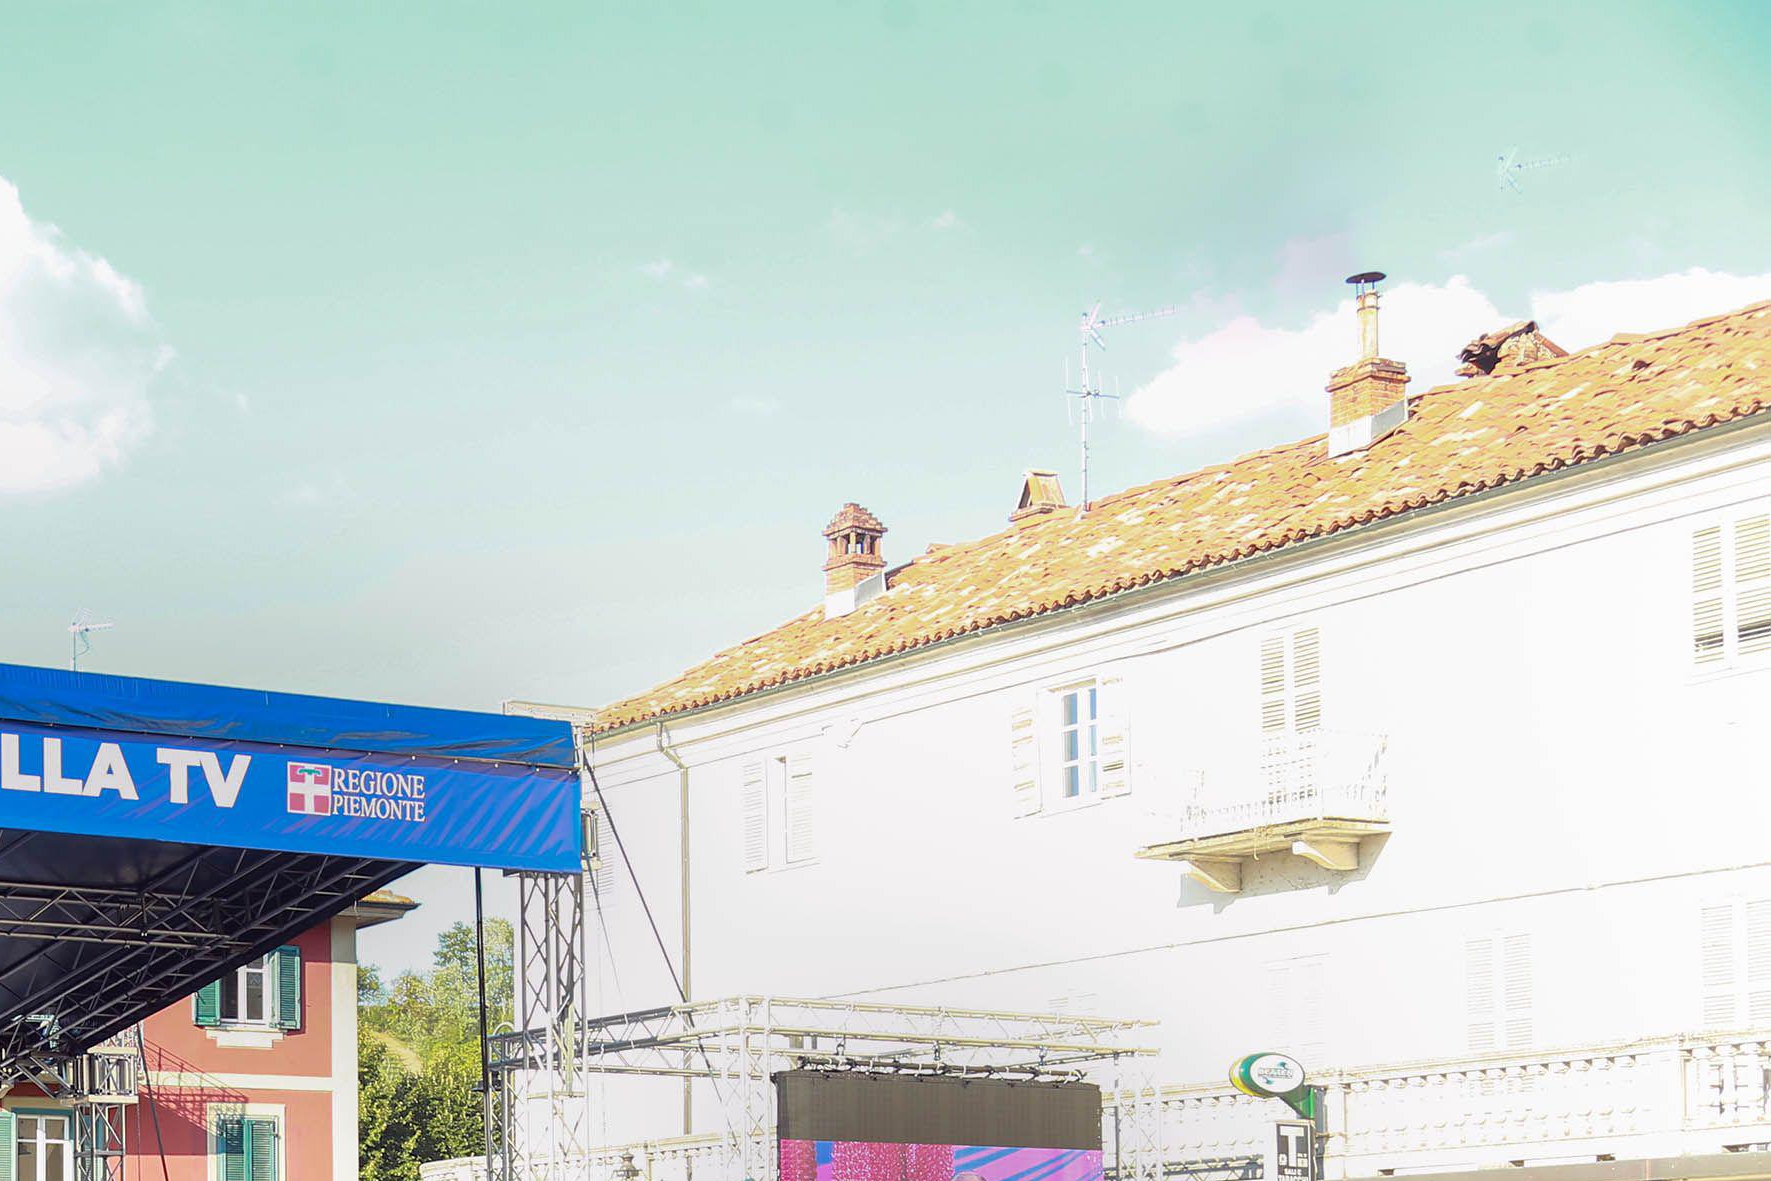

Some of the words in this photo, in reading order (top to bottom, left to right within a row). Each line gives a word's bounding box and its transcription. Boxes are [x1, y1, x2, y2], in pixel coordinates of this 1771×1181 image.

[156, 747, 251, 808] TV
[333, 767, 425, 799] REGIONE
[333, 795, 425, 823] PIEMONTE
